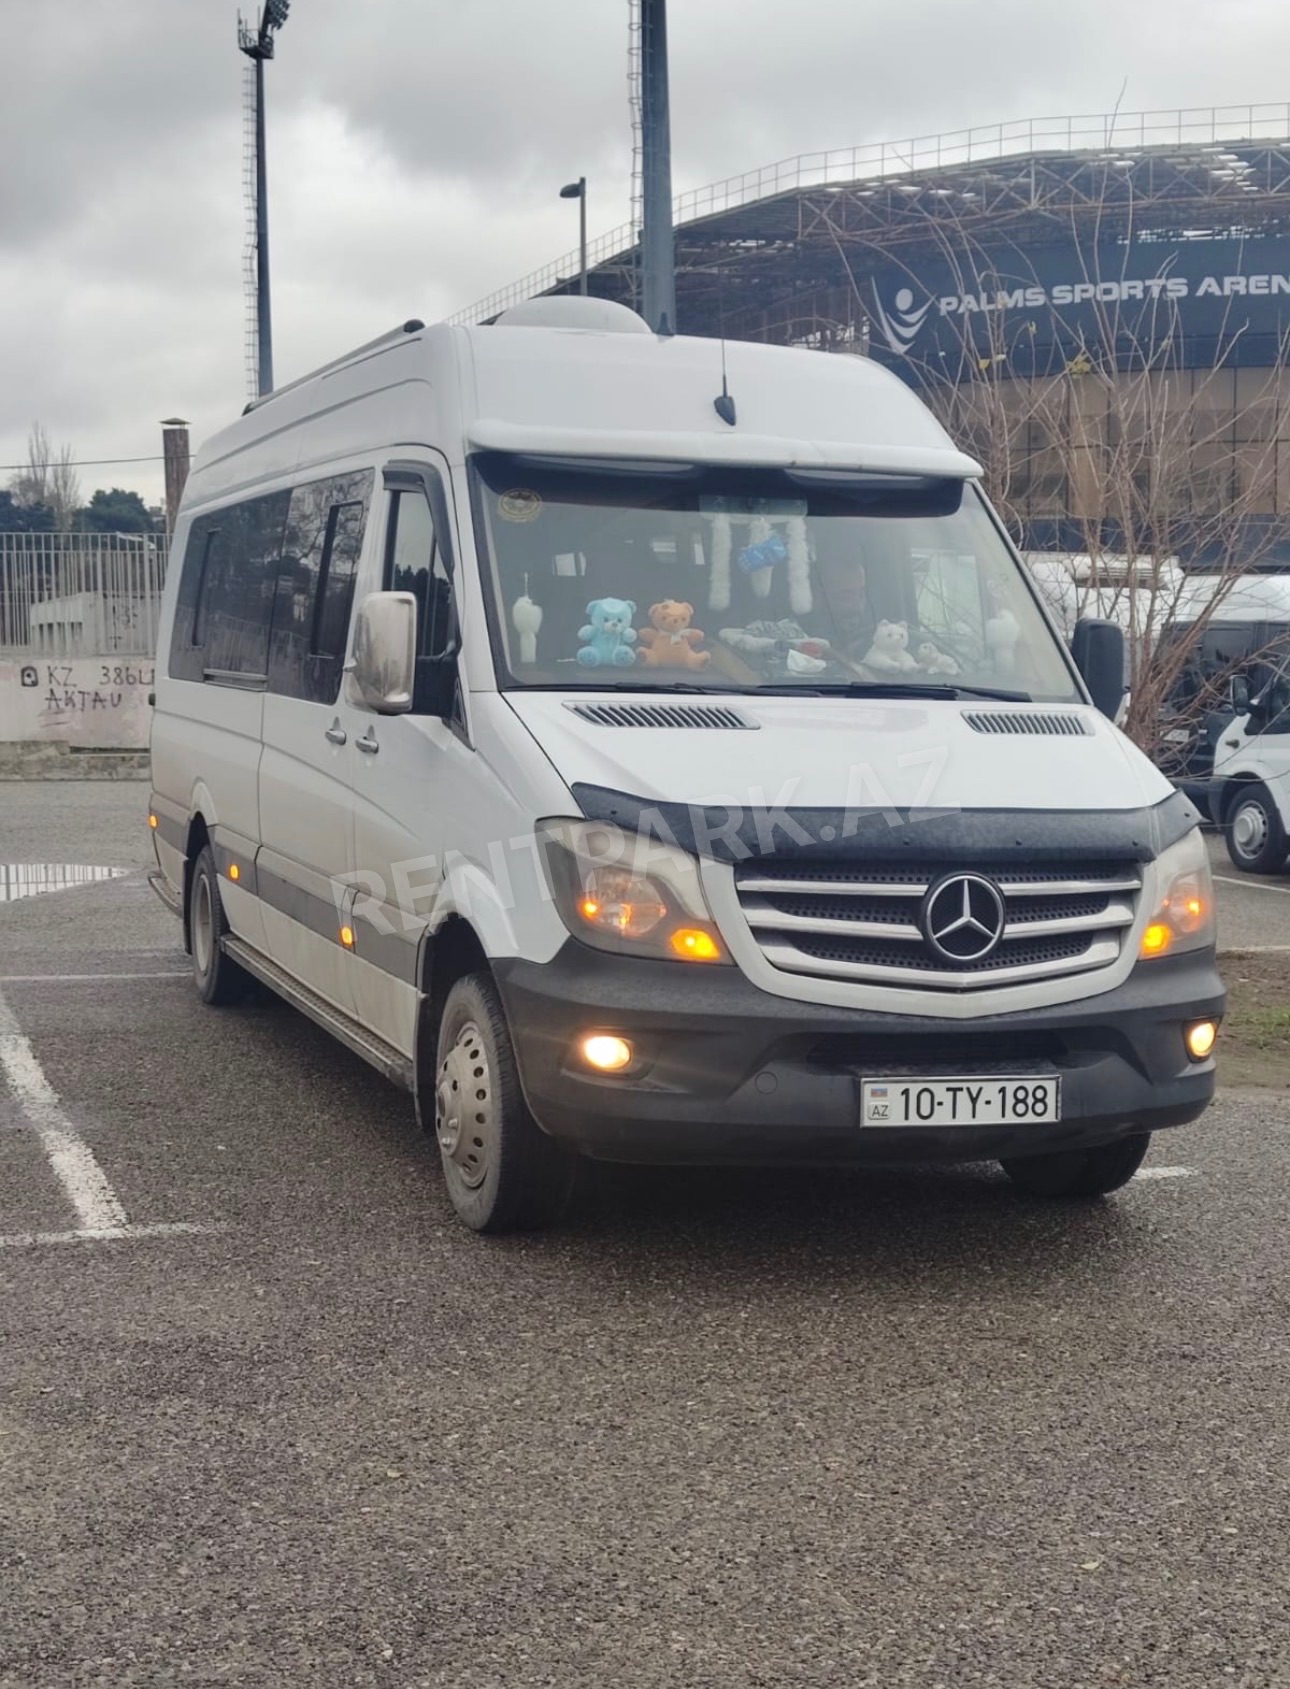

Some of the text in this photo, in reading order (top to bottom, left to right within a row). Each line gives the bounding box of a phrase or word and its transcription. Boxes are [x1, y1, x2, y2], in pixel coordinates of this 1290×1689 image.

[939, 287, 1046, 316] PALMS
[1052, 277, 1189, 305] SPORTS
[47, 665, 77, 687] KZ
[45, 688, 122, 711] AKTAU
[871, 1104, 889, 1117] AZ
[901, 1085, 1048, 1121] 10-TY-188
